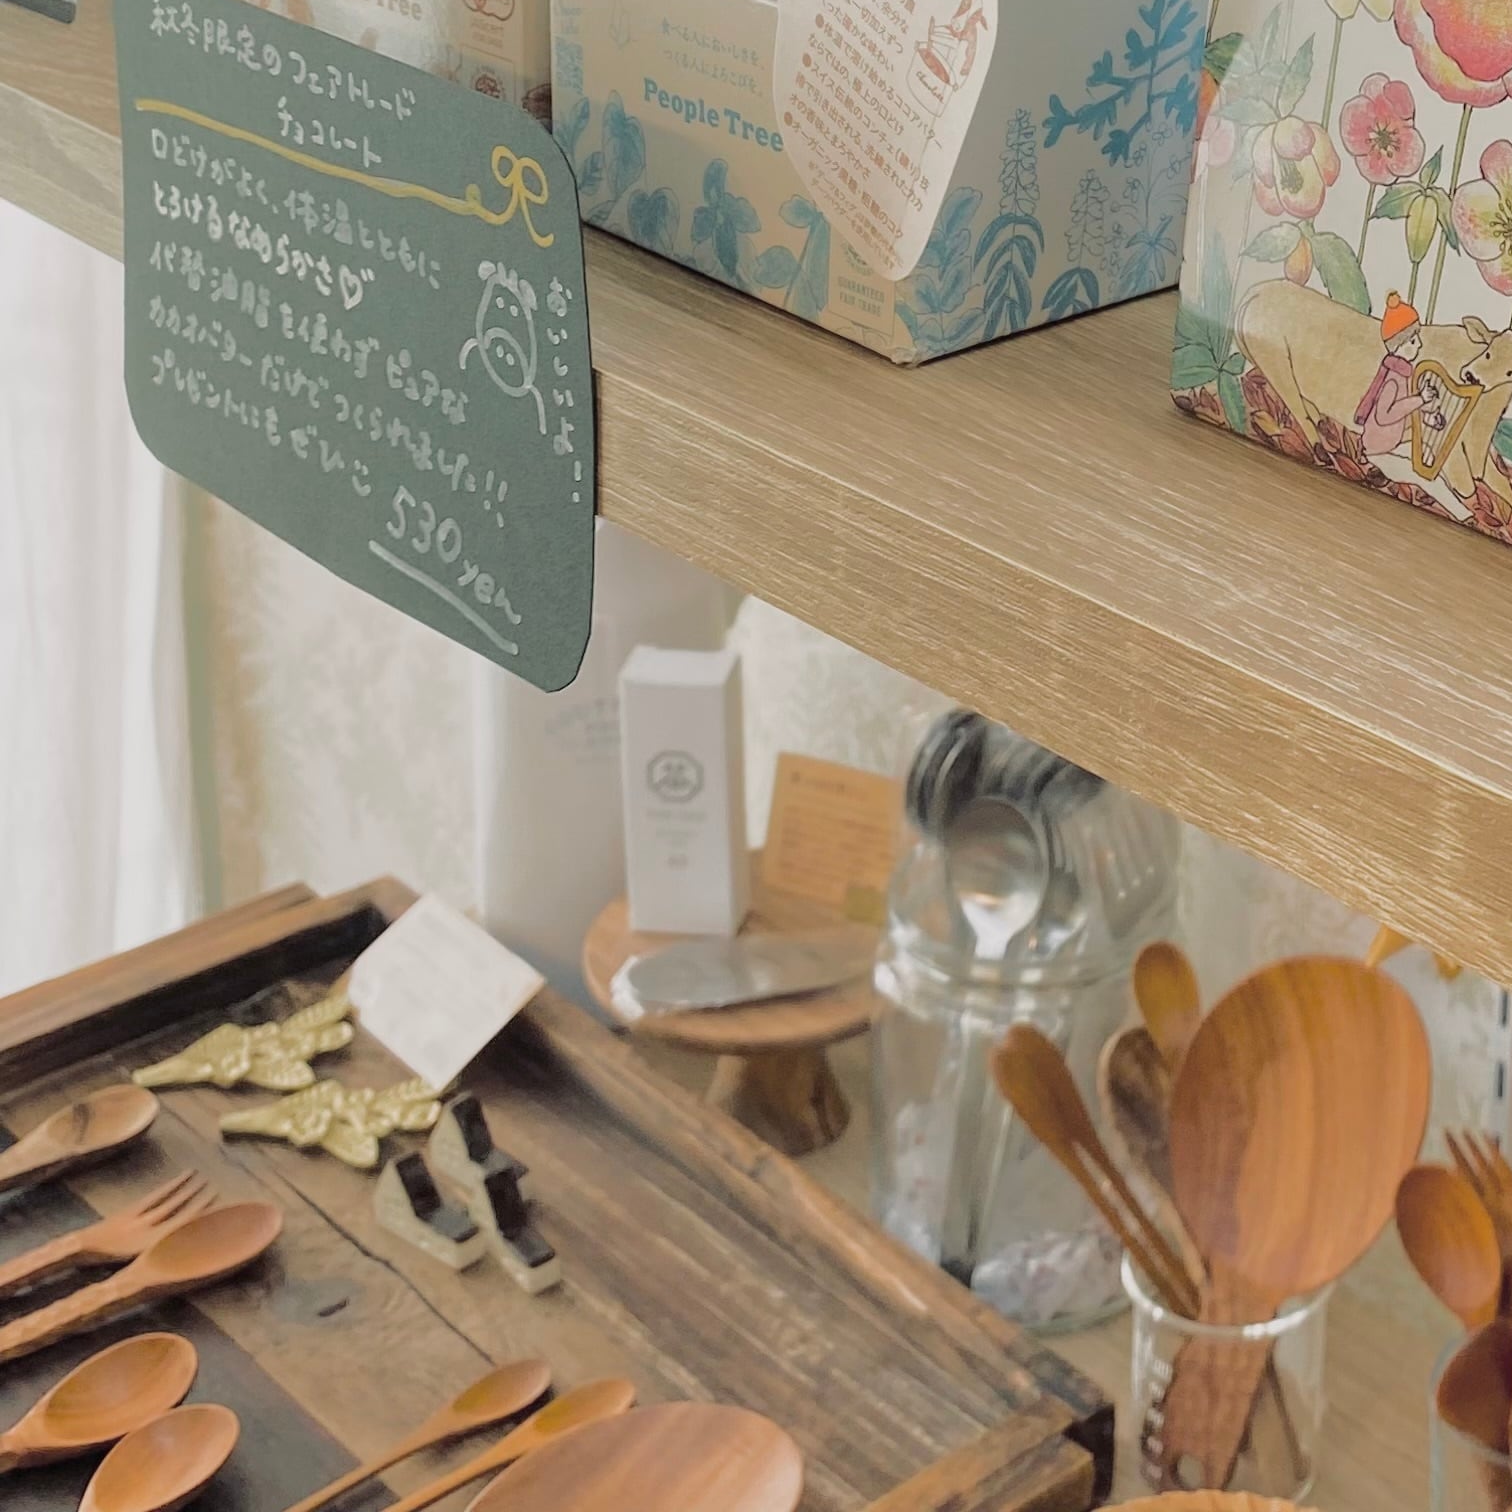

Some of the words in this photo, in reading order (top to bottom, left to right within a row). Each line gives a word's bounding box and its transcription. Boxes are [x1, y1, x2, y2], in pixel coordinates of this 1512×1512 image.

[277, 95, 382, 168] チョコレート
[643, 77, 721, 128] People
[723, 108, 784, 153] Tree
